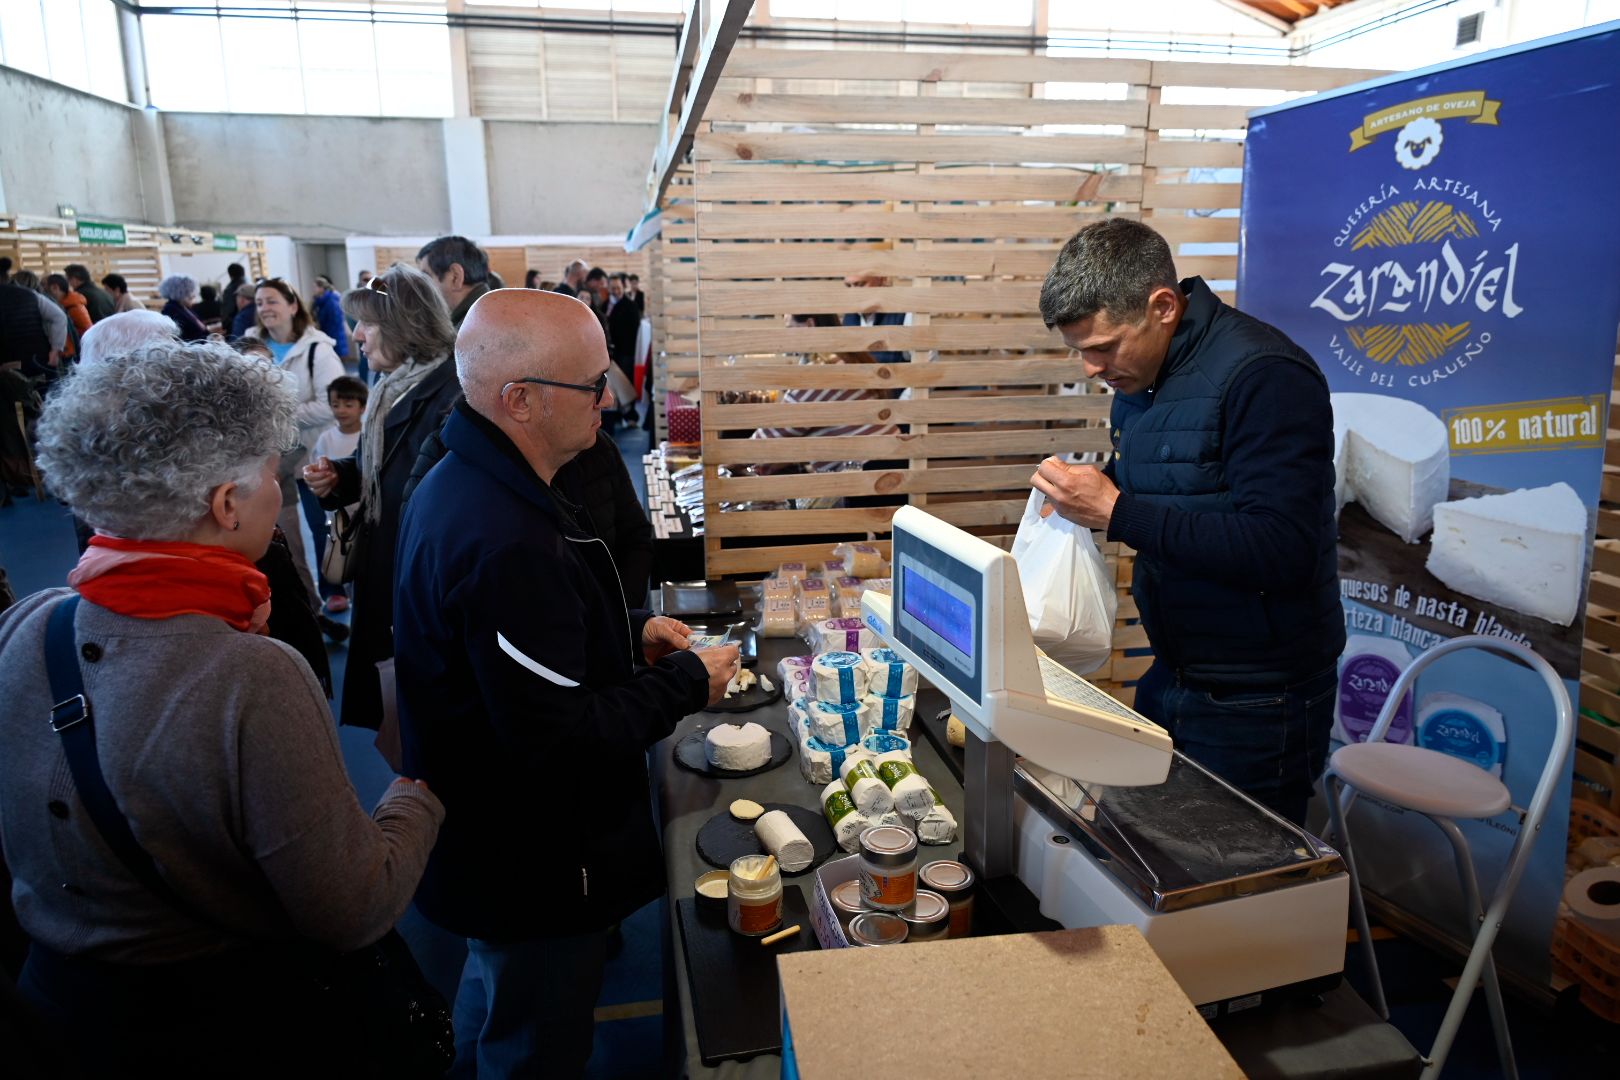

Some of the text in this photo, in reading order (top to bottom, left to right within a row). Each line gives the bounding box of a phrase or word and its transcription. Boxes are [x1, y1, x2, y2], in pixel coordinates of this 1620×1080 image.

[1370, 99, 1477, 129] ARTESANO DE OVEJA
[1334, 177, 1502, 247] QUESERÍA ARTESANA
[1329, 332, 1491, 387] VALLE DEL CURUEÑO
[1452, 405, 1597, 444] 100% natural
[1341, 578, 1388, 604] quesos
[1394, 584, 1411, 609] de
[1415, 595, 1469, 628] pasta
